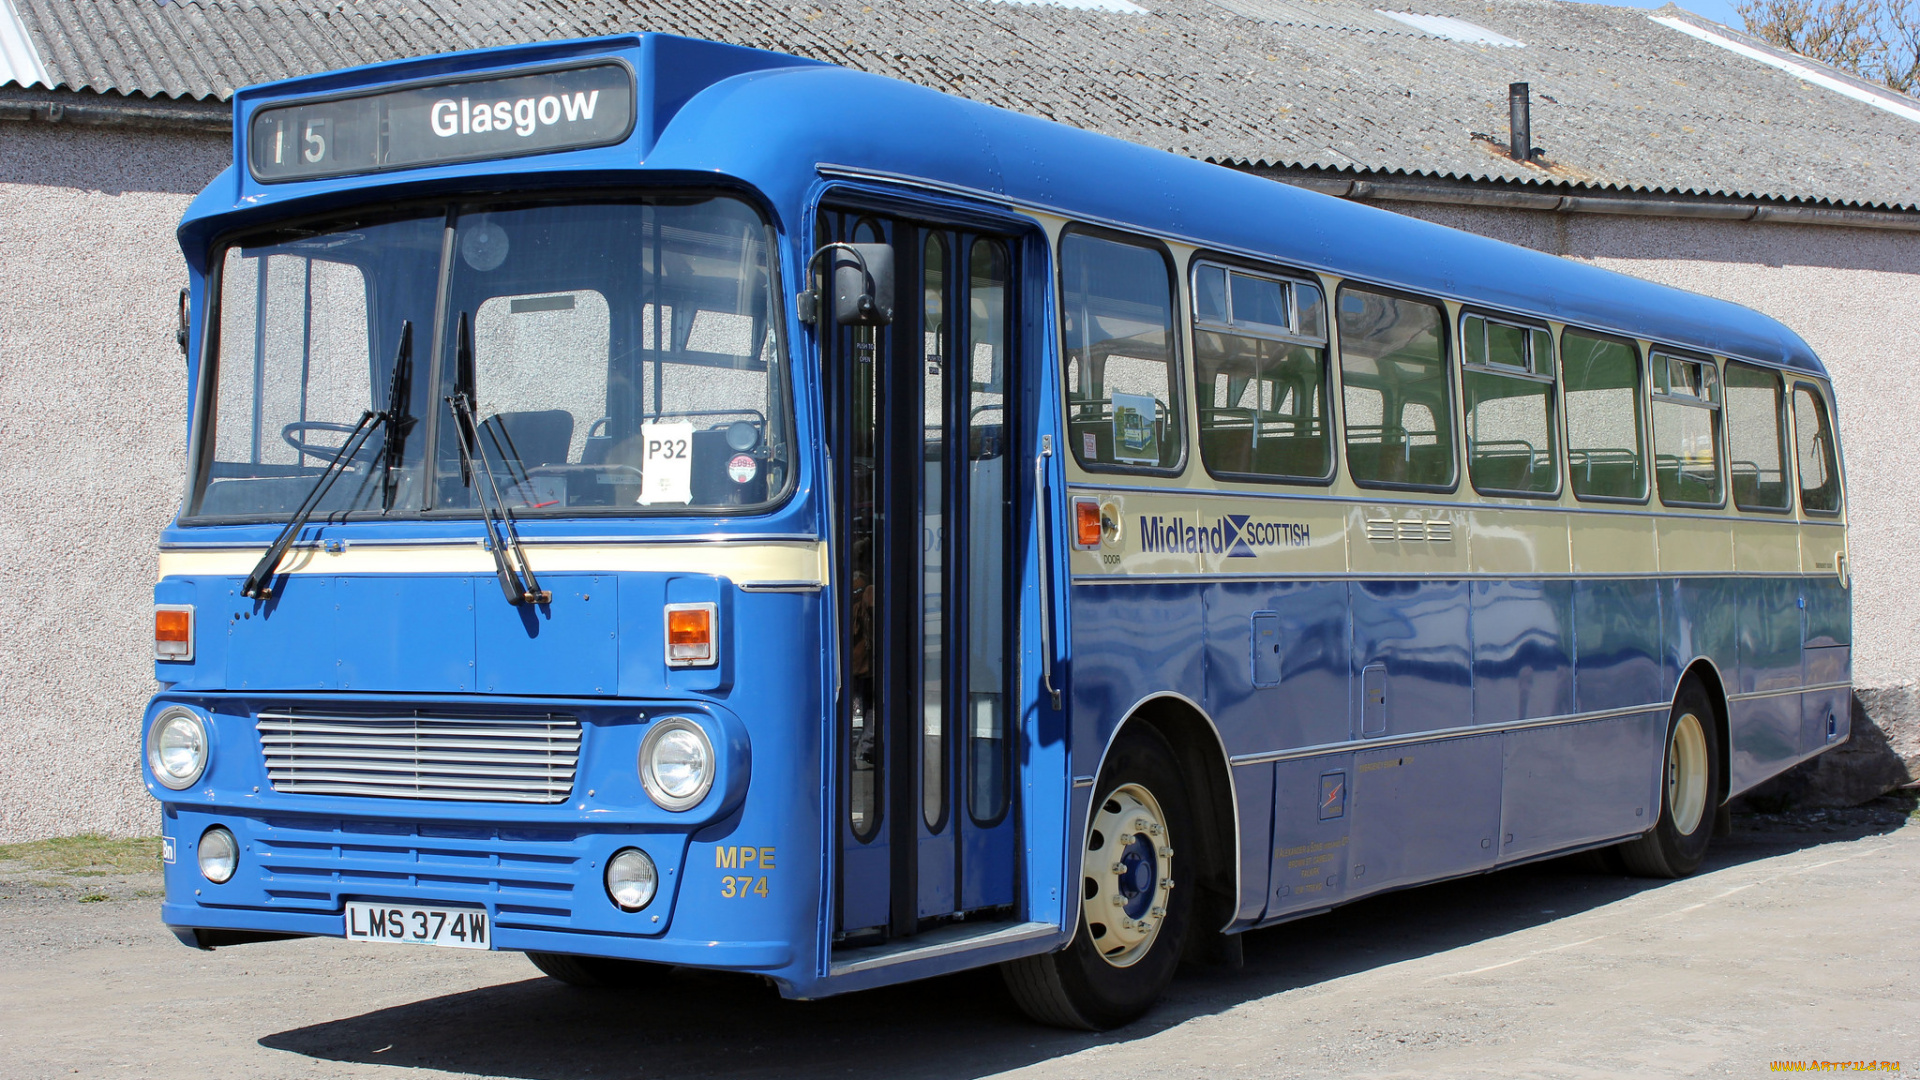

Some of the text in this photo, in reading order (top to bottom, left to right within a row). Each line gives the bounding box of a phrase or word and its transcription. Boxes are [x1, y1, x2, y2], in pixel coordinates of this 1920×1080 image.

[431, 90, 599, 137] Glasgow
[649, 439, 687, 459] P32
[1140, 516, 1310, 554] Midland SCOTTISH
[1103, 554, 1121, 564] DOOR
[716, 846, 776, 869] MPE
[721, 876, 769, 898] 374
[351, 908, 486, 943] LMS 374W
